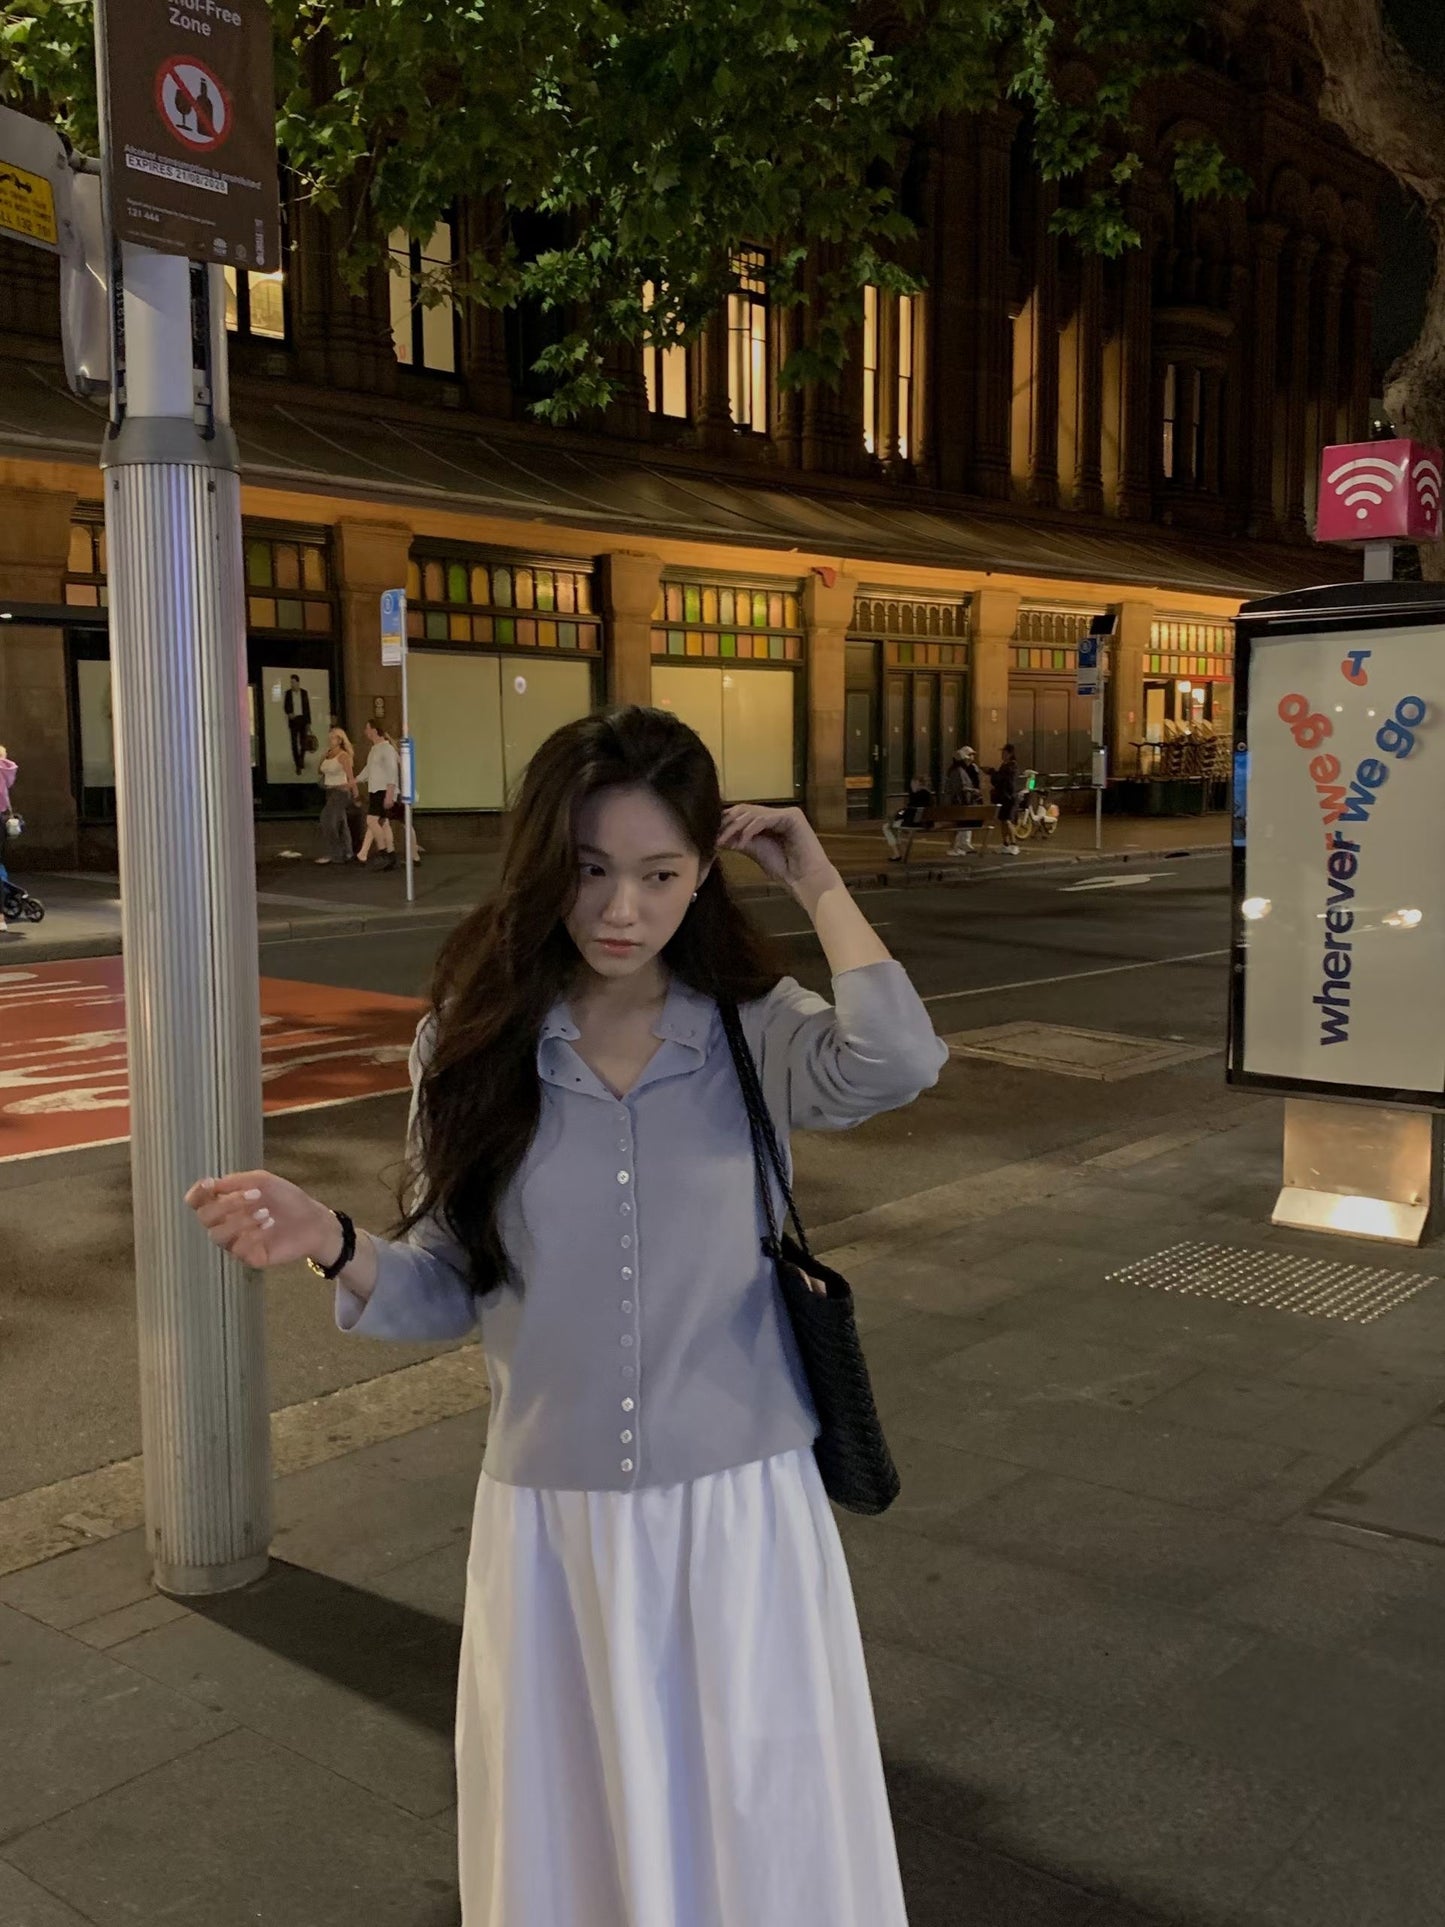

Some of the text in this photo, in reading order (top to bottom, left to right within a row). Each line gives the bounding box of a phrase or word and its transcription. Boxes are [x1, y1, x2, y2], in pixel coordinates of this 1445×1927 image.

[169, 7, 211, 36] Zone
[129, 155, 174, 177] EXPIRES
[1278, 693, 1349, 825] we go
[1313, 696, 1426, 1046] wherever we go
